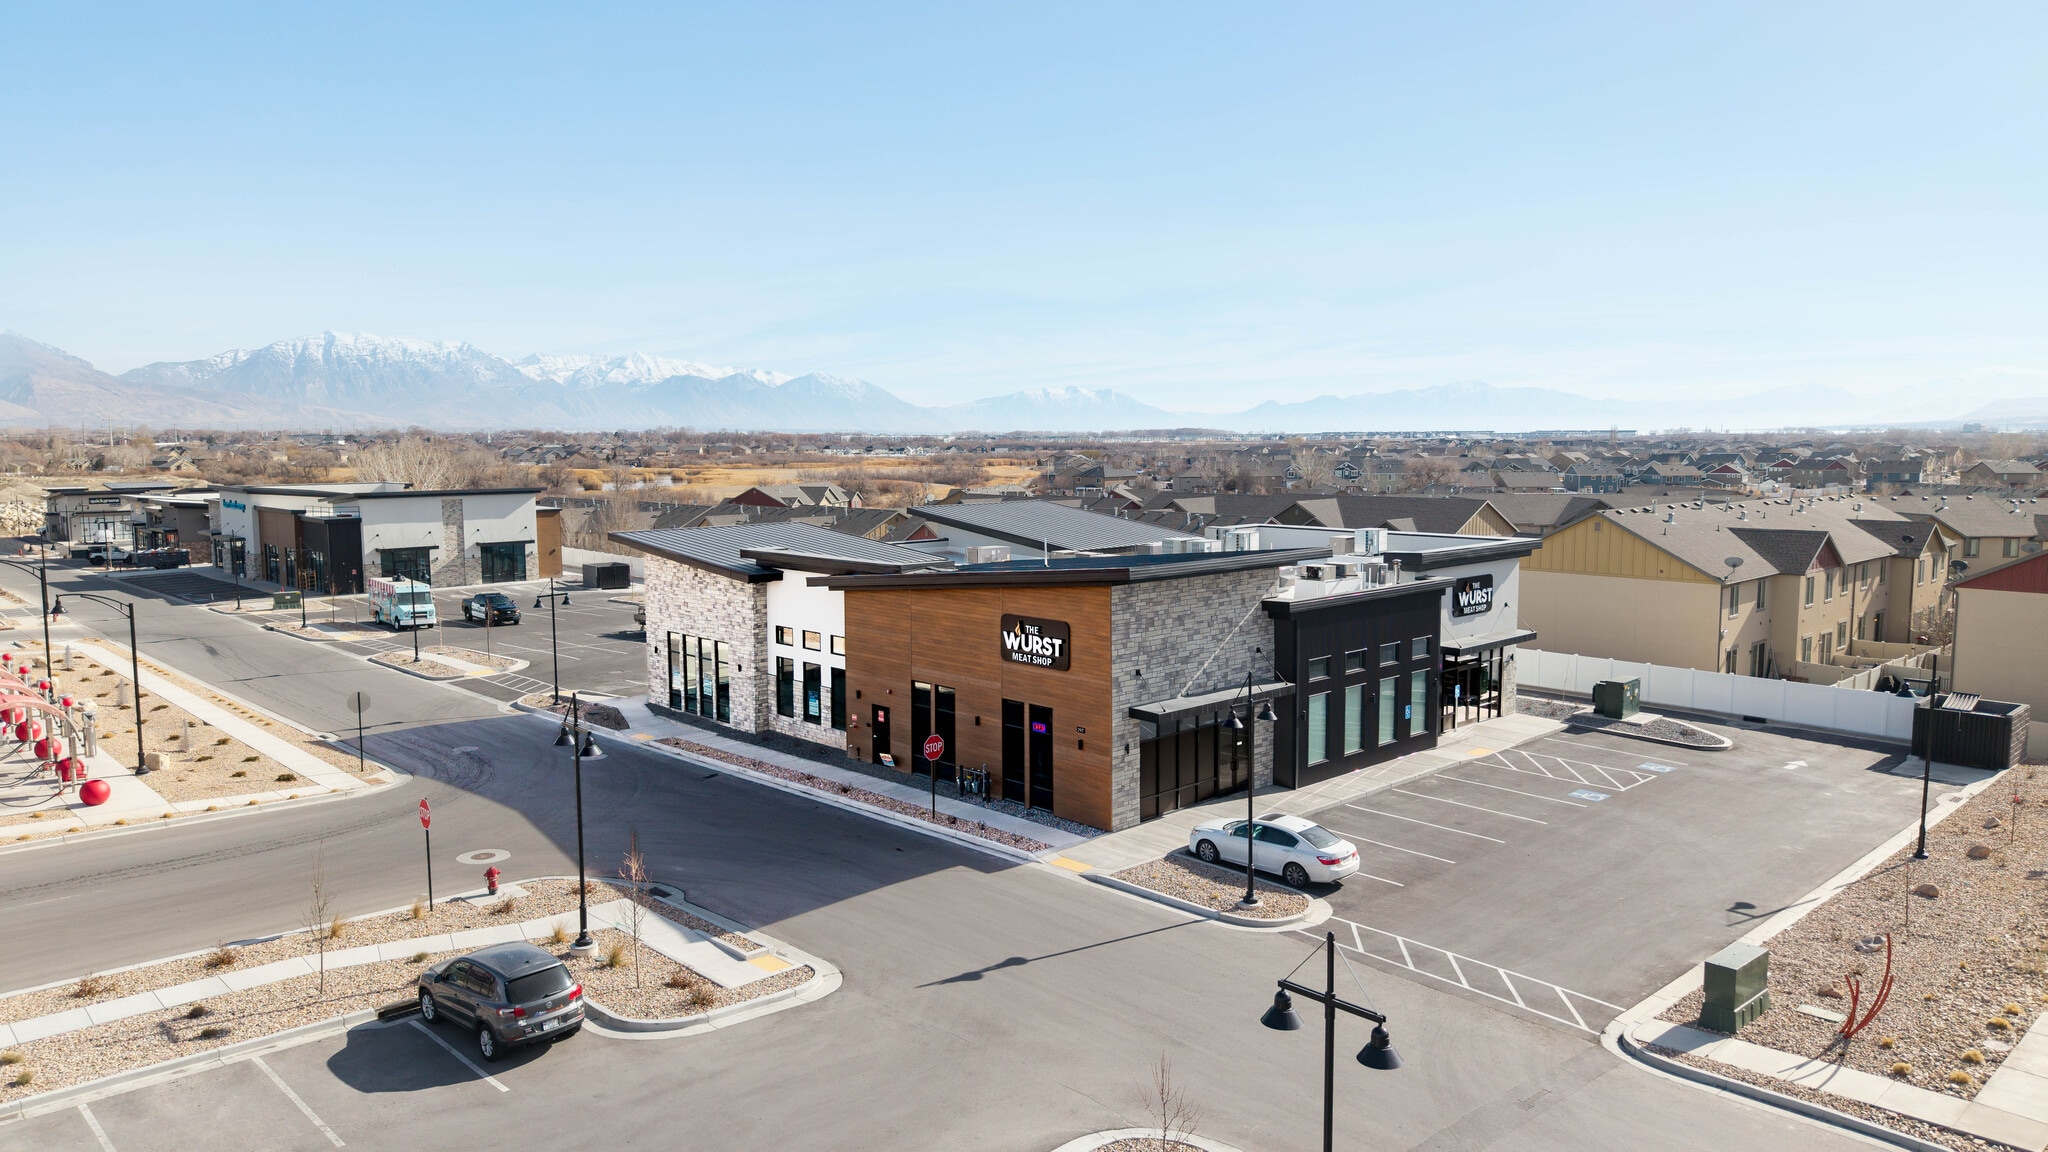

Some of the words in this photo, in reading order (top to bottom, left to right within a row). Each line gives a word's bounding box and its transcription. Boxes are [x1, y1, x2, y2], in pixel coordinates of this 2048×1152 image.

[1458, 588, 1493, 607] WURST
[1463, 606, 1475, 615] MEAT
[1025, 625, 1039, 635] THE
[1003, 630, 1062, 657] WURST
[1012, 652, 1031, 663] MEAT
[1033, 655, 1052, 666] SHOP
[1033, 723, 1044, 731] OPEN
[925, 741, 943, 753] STOP
[418, 806, 430, 819] STOP
